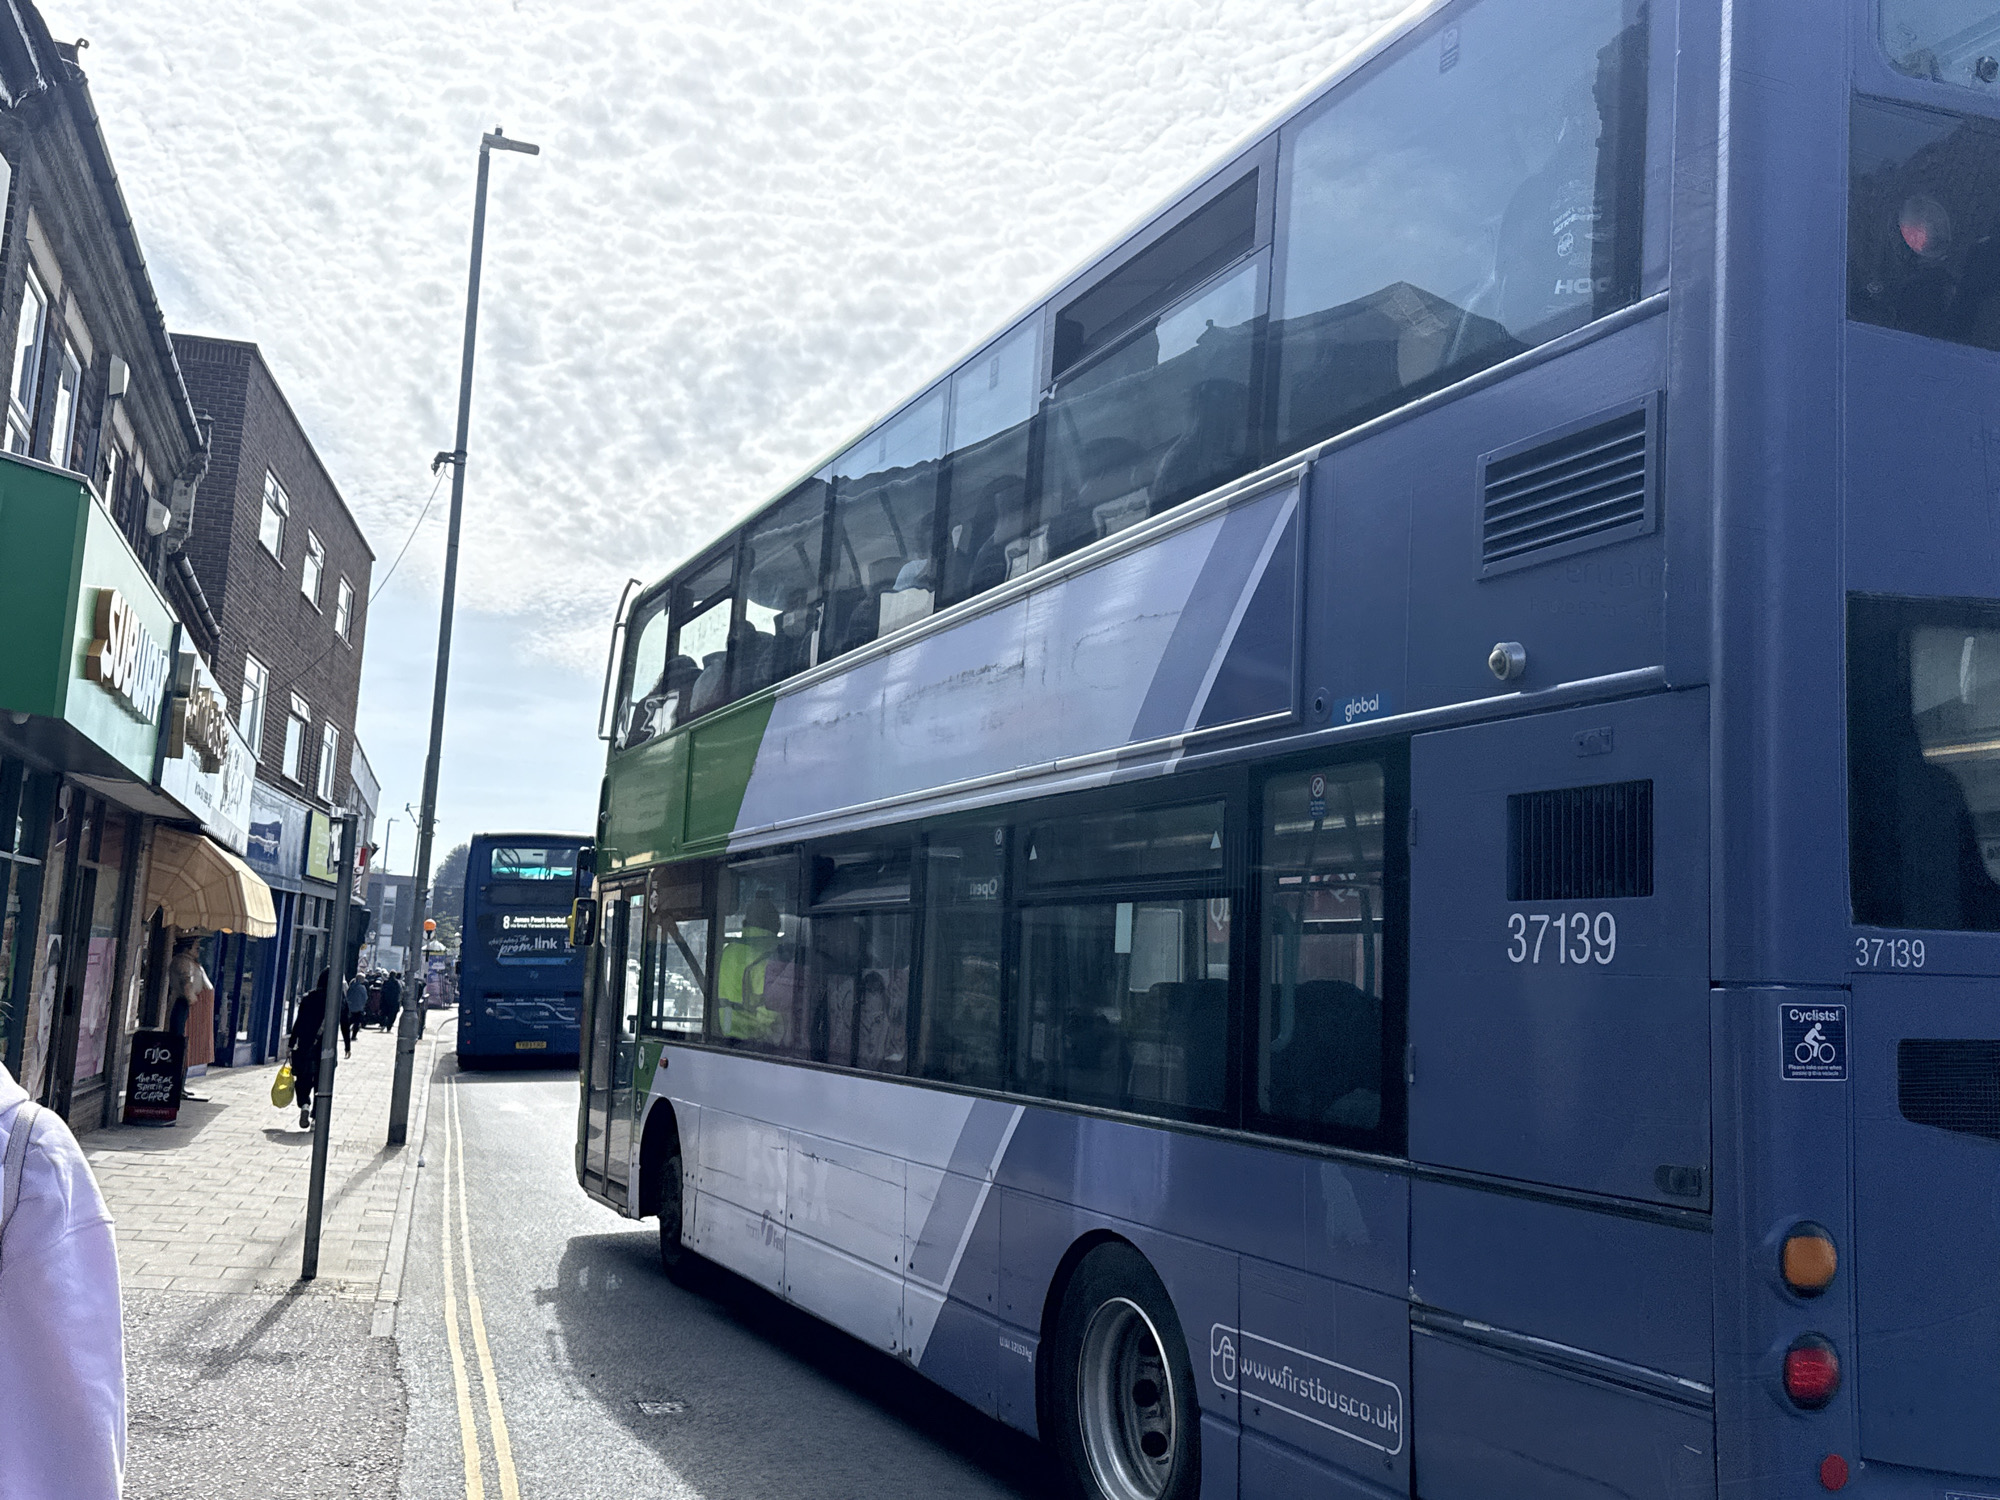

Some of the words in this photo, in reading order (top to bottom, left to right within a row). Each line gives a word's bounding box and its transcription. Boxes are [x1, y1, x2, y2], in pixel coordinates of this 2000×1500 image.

[101, 588, 170, 726] SUBWAY
[1345, 693, 1379, 722] global
[503, 915, 510, 929] 8
[534, 933, 558, 950] link
[1507, 912, 1616, 965] 37139
[1855, 937, 1926, 968] 37139
[1789, 1009, 1839, 1022] Cyclists!
[1239, 1356, 1398, 1433] www.firstbus.co.uk
